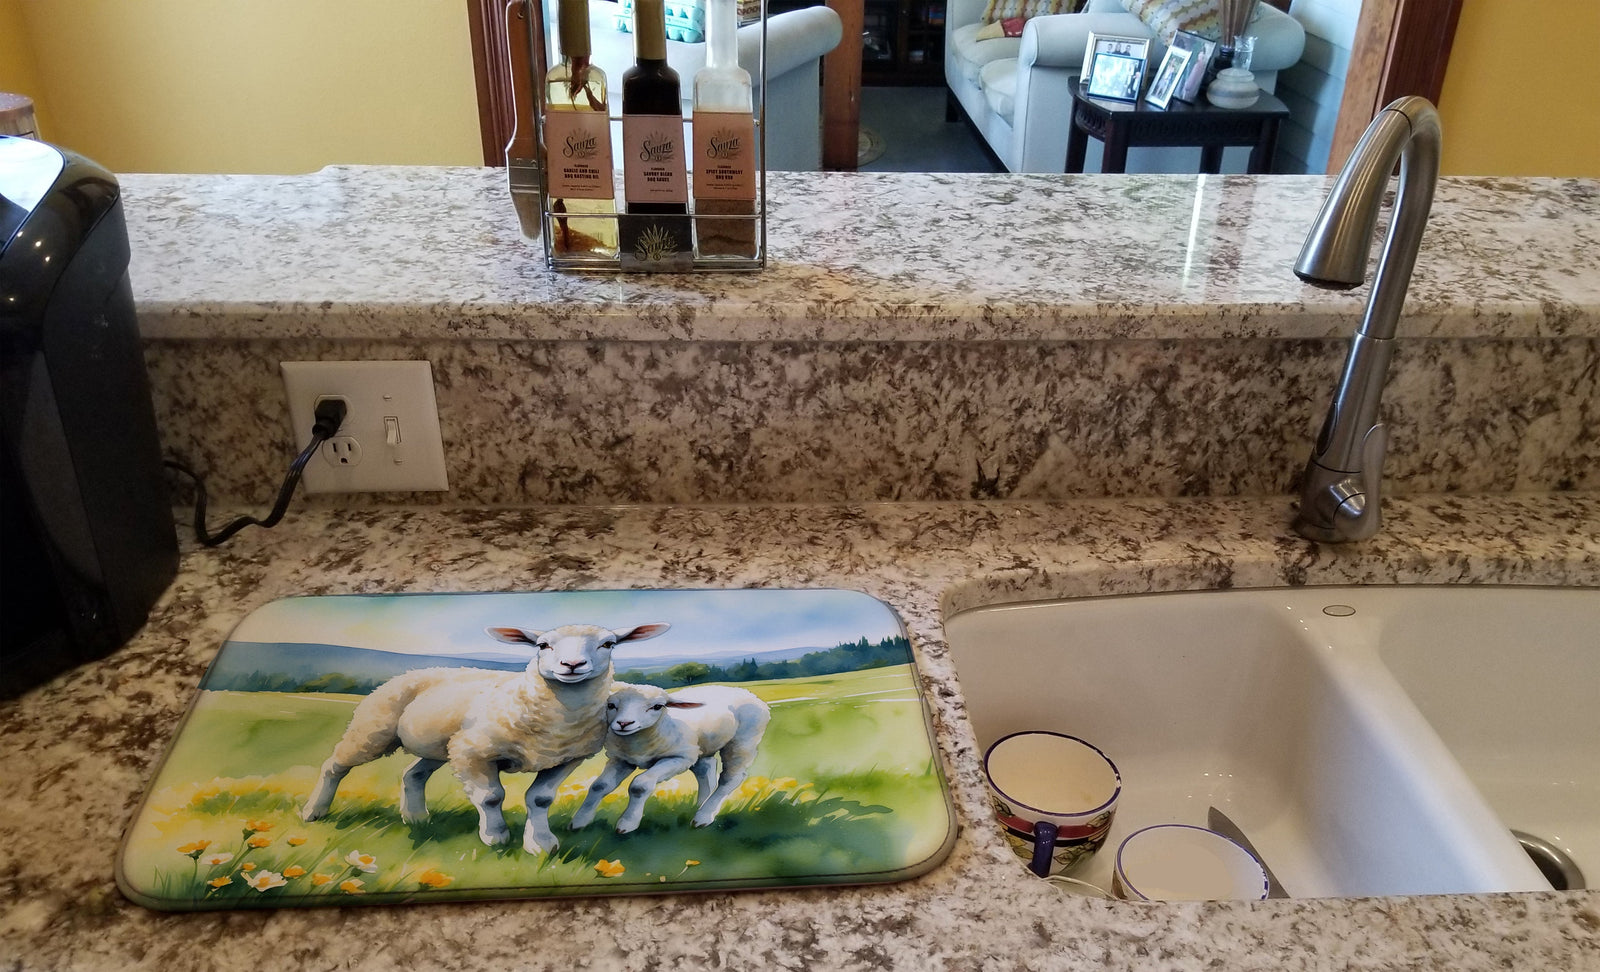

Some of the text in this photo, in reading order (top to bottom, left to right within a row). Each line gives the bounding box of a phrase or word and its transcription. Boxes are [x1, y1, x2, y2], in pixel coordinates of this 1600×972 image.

[562, 136, 598, 158] Sauza
[639, 140, 673, 161] Sauza
[707, 136, 740, 158] Sauza
